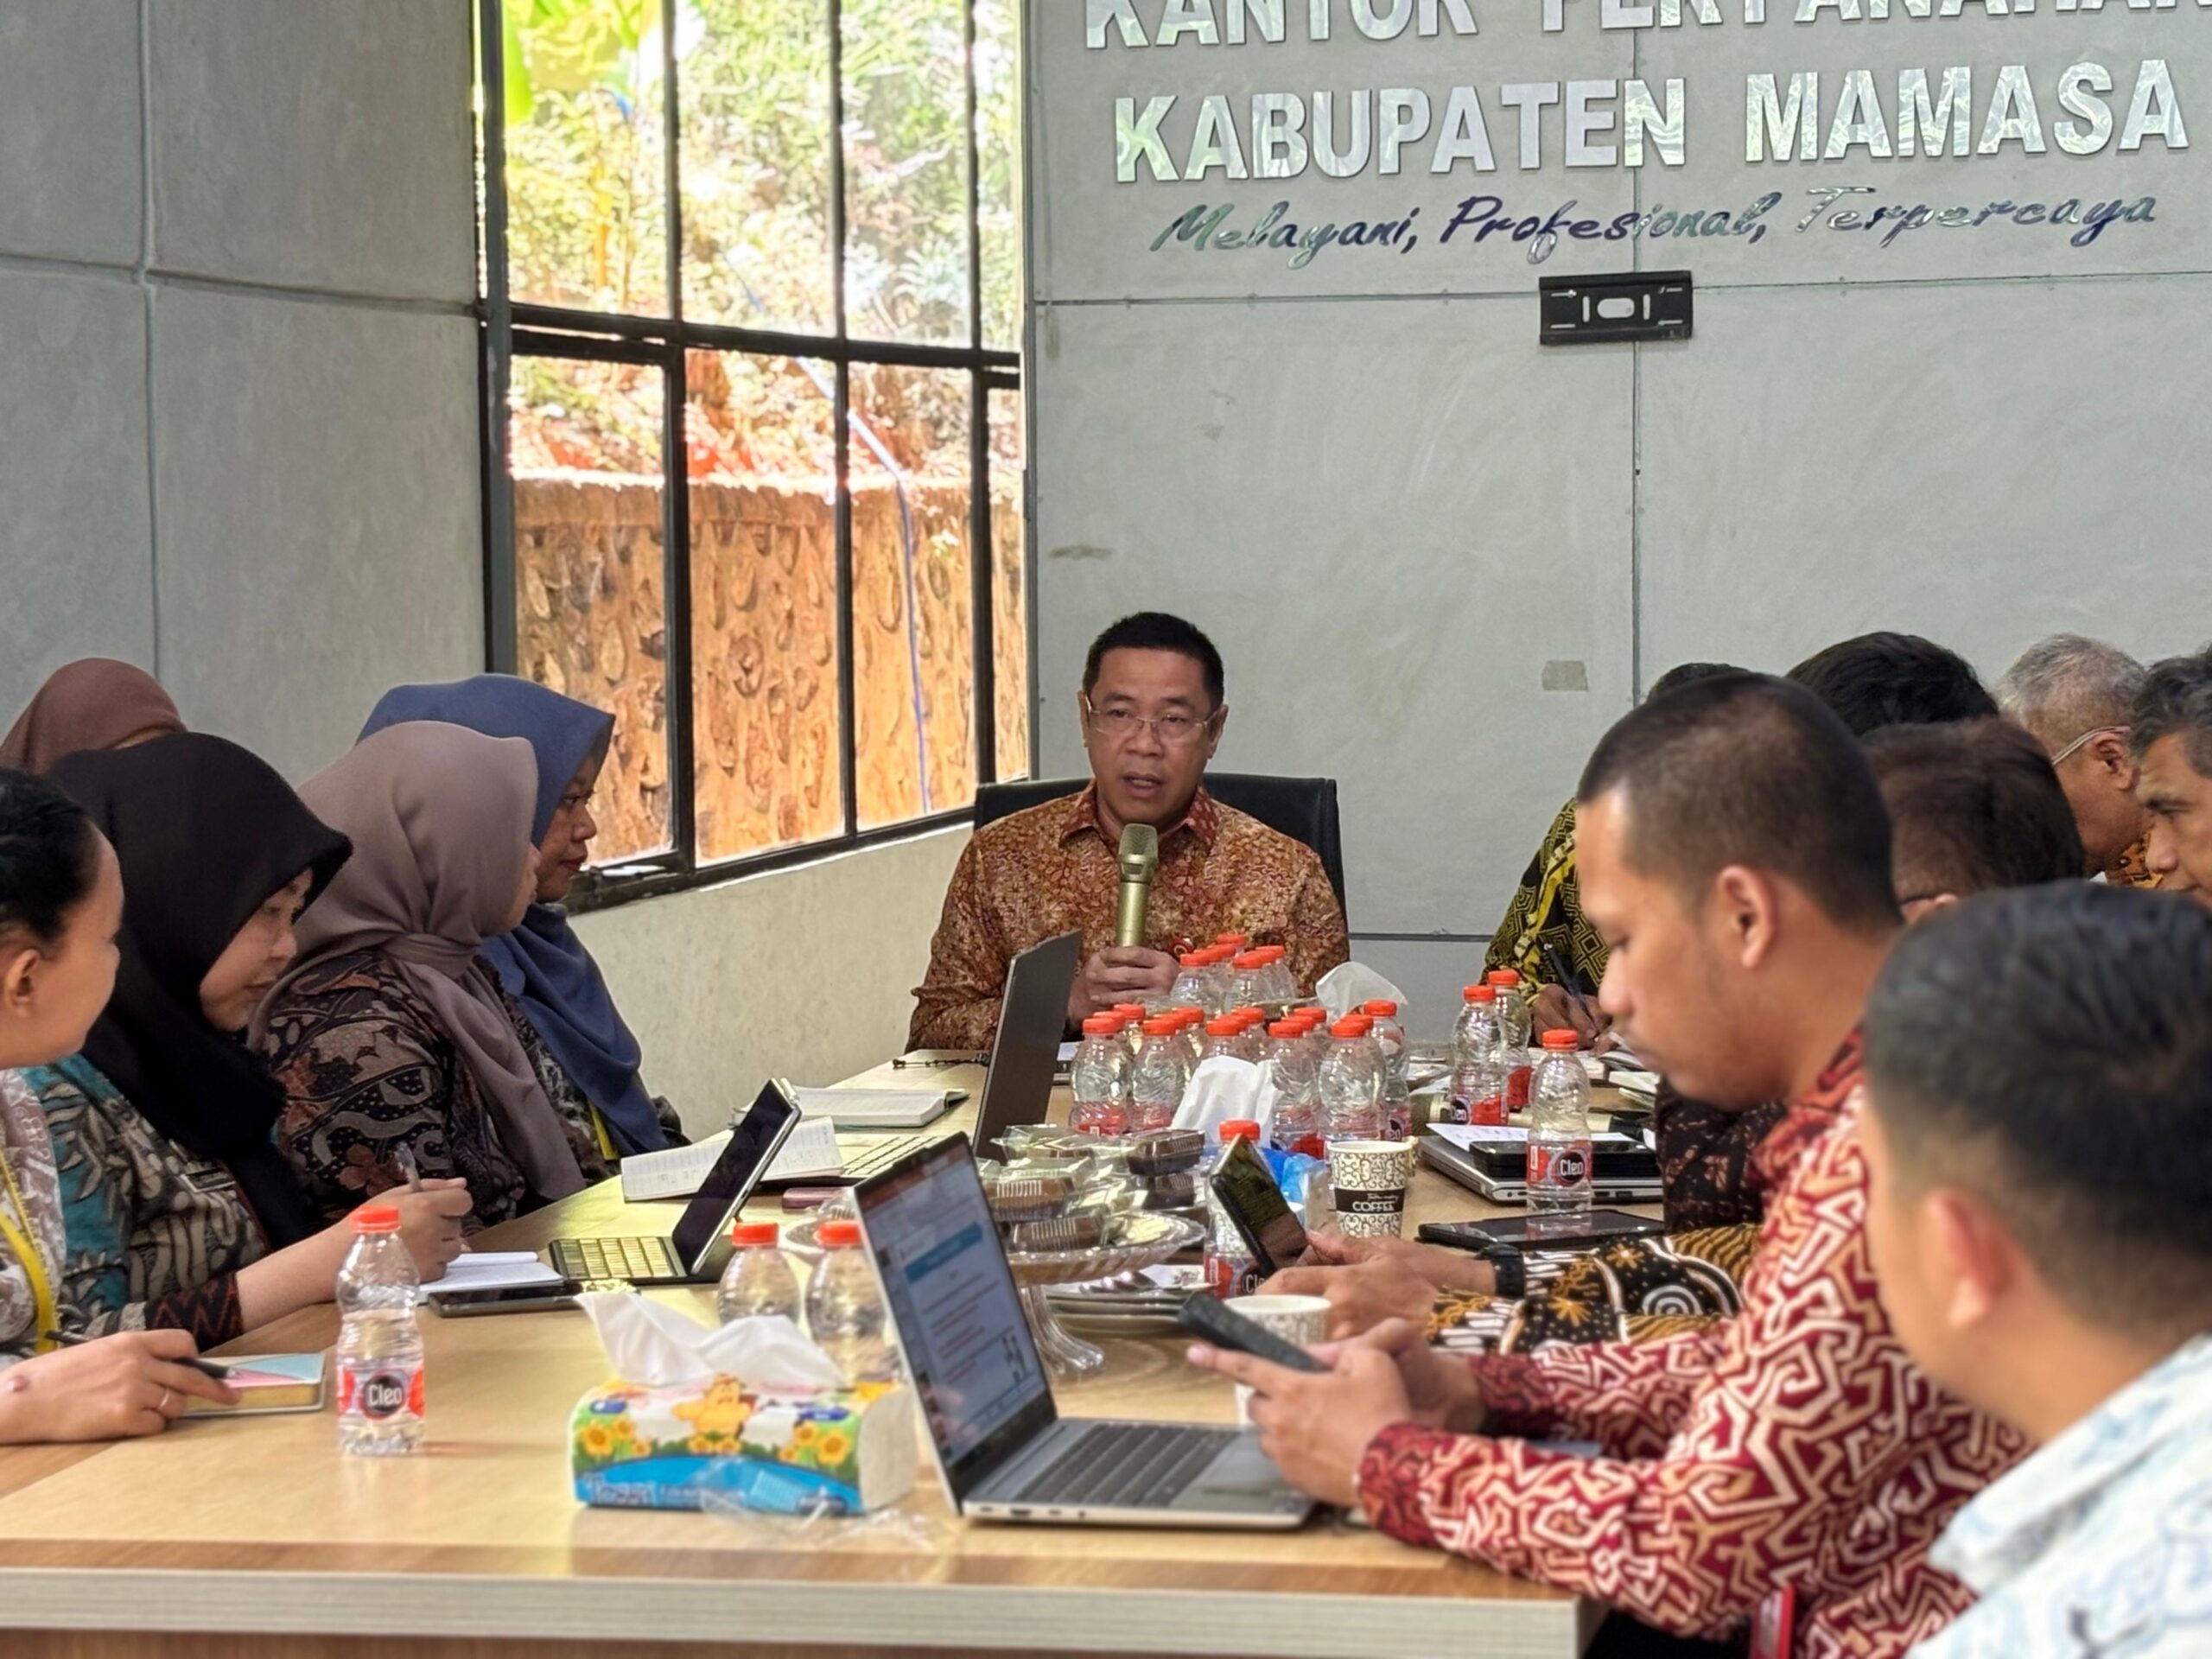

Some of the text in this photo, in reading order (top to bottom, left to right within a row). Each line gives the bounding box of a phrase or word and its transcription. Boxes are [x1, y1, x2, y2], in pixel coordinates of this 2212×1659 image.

[1116, 59, 2189, 182] KABUPATEN MAMASA
[1149, 186, 2157, 270] Melayani, Profesional, Terpercaya
[1559, 1159, 1584, 1176] Cleo
[368, 1383, 404, 1408] Cleo
